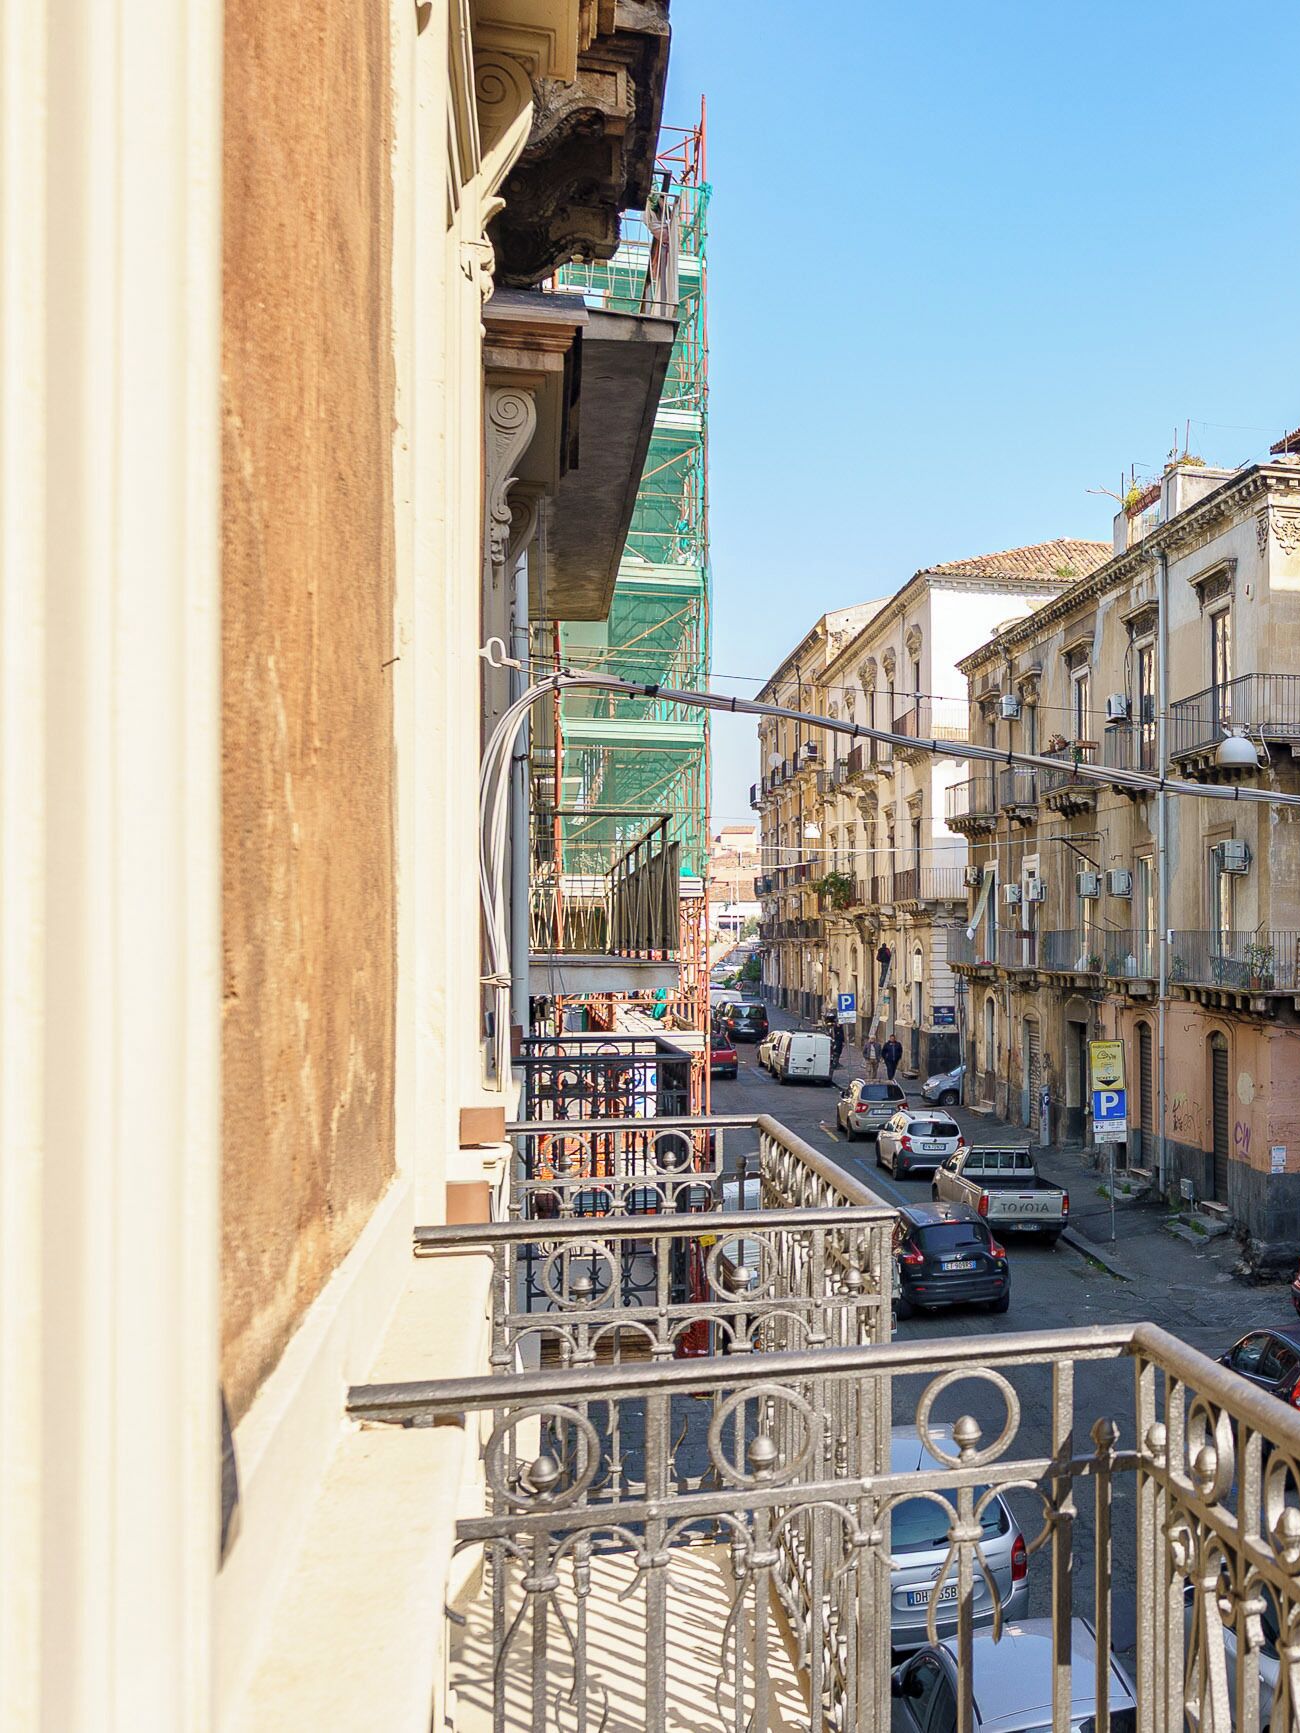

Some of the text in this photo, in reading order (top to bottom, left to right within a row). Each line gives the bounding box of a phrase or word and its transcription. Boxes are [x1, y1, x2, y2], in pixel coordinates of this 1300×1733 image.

[841, 995, 852, 1010] P
[1100, 1091, 1119, 1116] P
[1001, 1202, 1049, 1213] TOYOTA
[915, 1591, 929, 1603] DH
